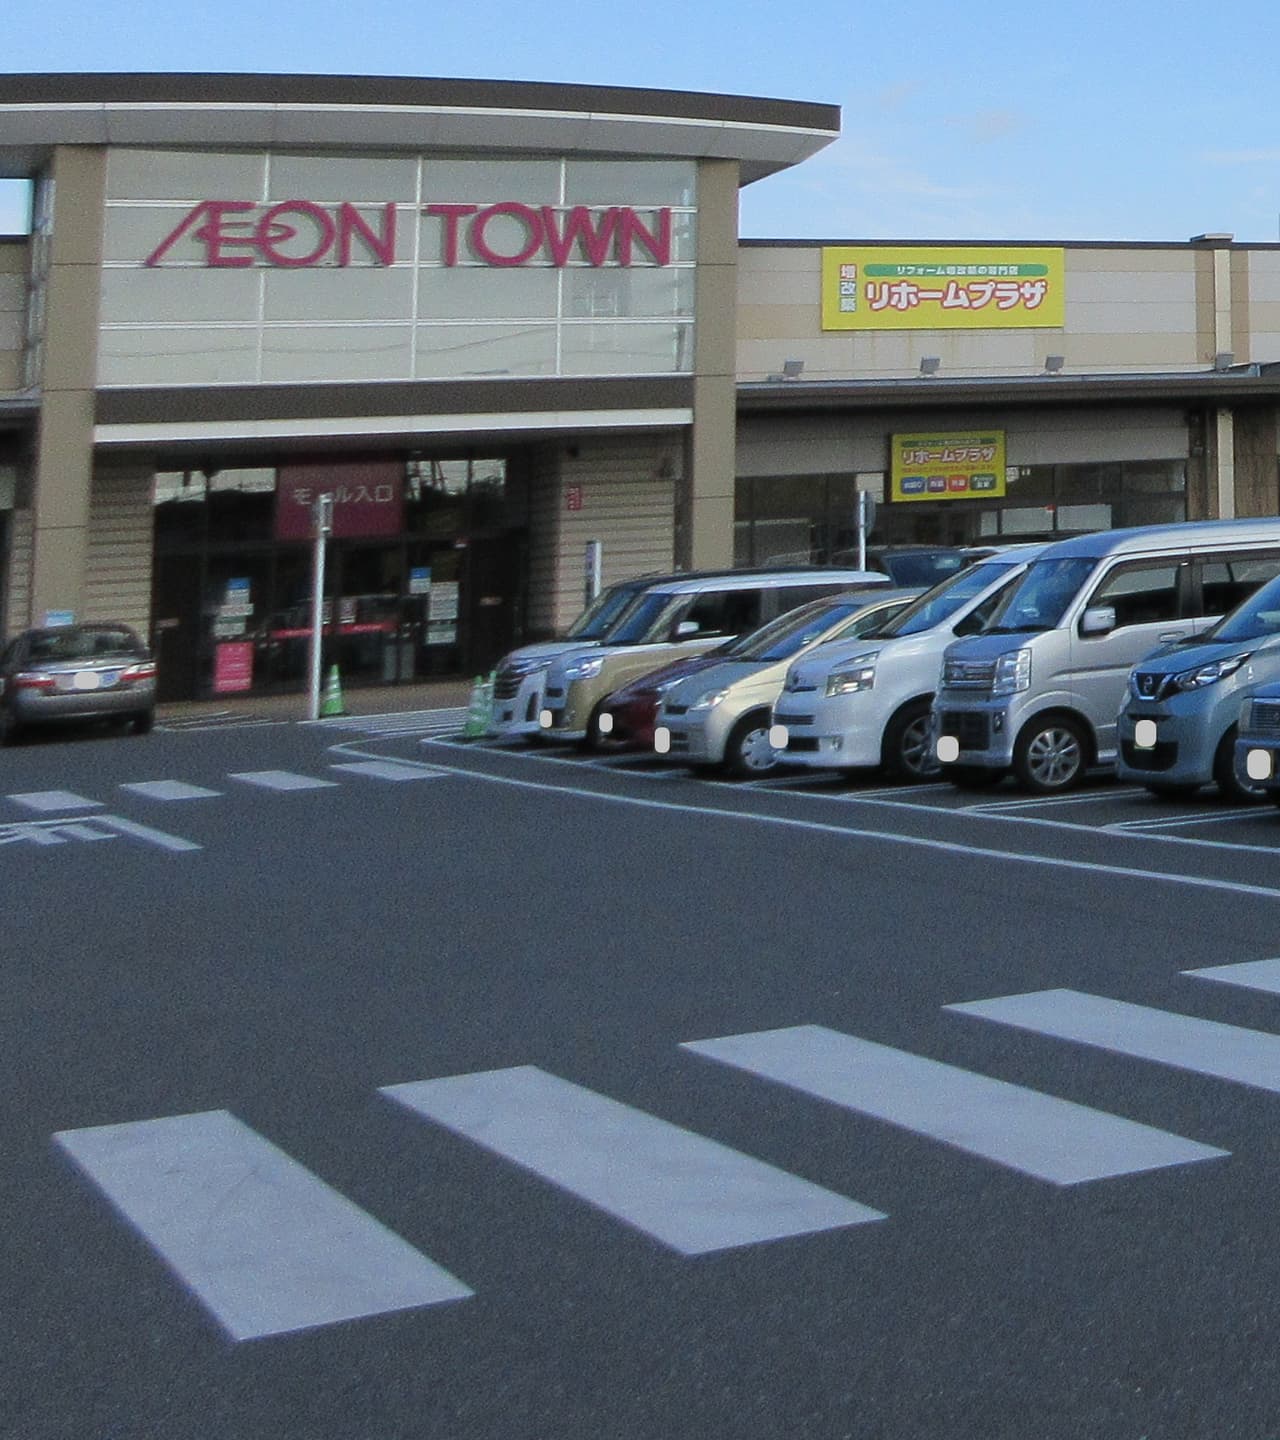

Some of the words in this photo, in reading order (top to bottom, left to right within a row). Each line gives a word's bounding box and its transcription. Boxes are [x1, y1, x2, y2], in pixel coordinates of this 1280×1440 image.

[424, 201, 672, 268] TOWN
[865, 280, 1047, 310] リホームプラザ
[902, 447, 996, 464] リホームプラザ
[294, 484, 394, 505] モル入口
